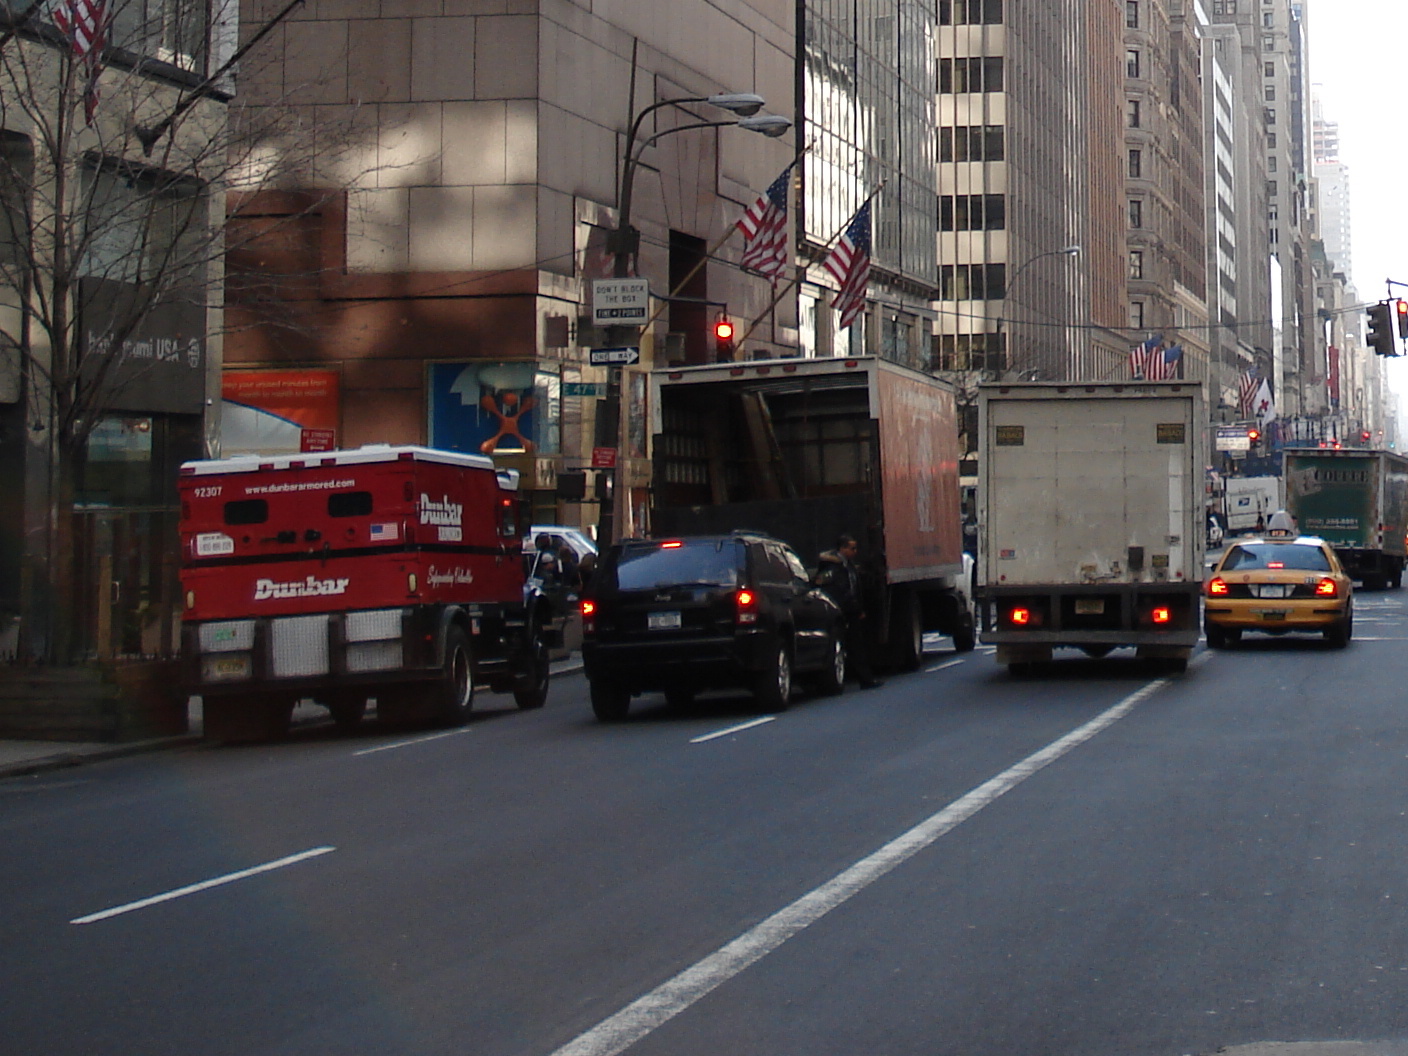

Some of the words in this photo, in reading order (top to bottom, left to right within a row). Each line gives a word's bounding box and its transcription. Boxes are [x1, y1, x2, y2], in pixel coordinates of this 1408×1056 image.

[621, 285, 644, 293] BLOCK
[605, 295, 618, 303] THE
[156, 338, 180, 362] USA
[594, 353, 609, 361] ONE
[194, 486, 222, 498] 92307
[245, 479, 355, 494] www.dunbararmored.com
[420, 493, 463, 525] Dunbar
[254, 575, 350, 600] Dunbar
